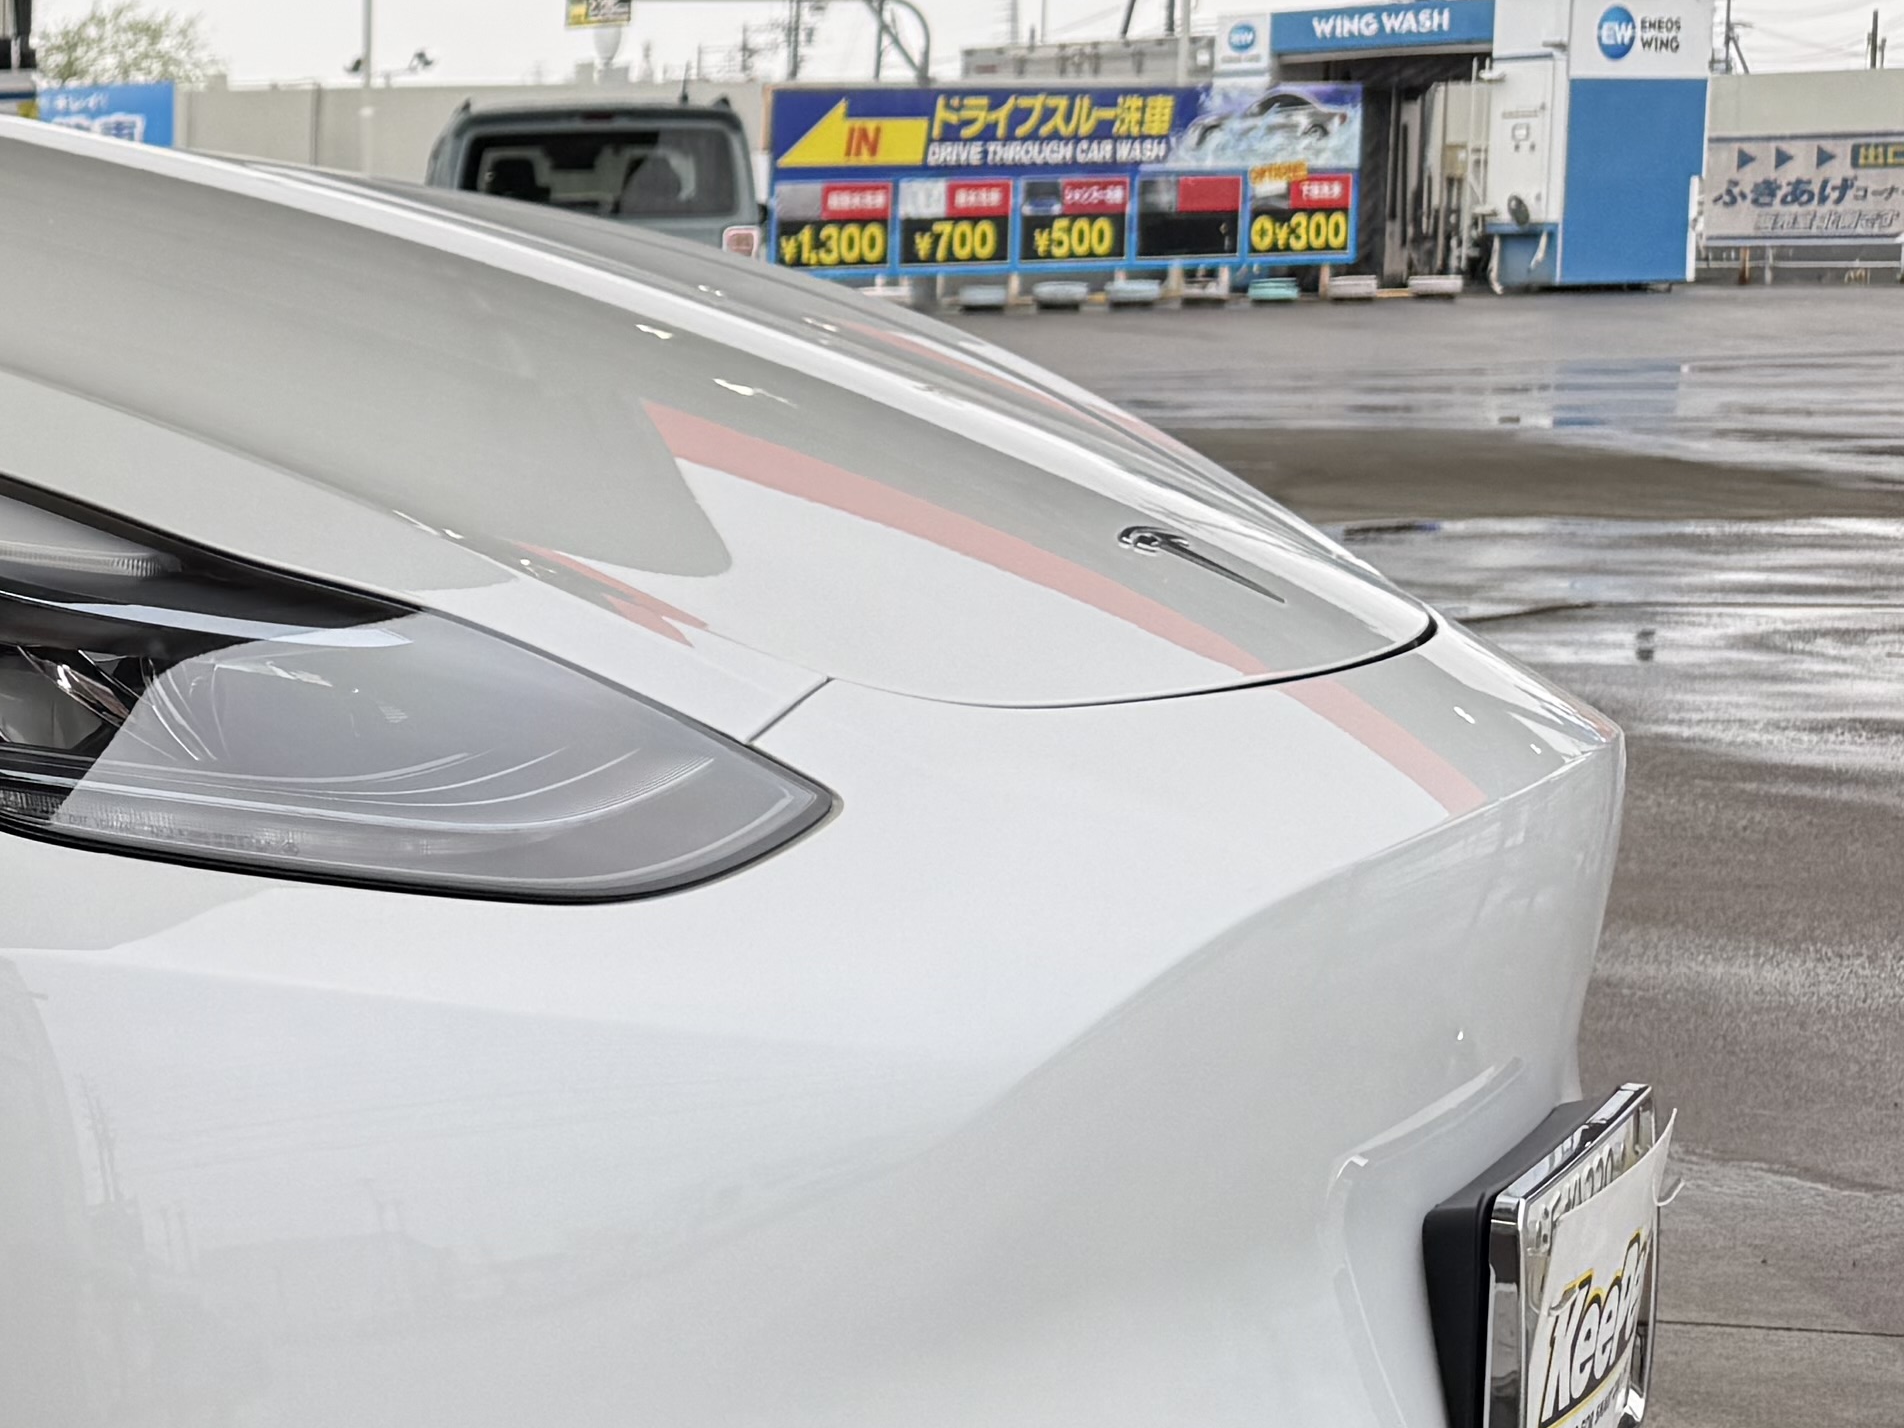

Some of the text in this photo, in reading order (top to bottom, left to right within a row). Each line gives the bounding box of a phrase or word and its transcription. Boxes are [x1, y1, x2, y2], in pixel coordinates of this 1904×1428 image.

[1312, 7, 1450, 40] WING WASH
[1640, 16, 1681, 33] ENEOS
[1640, 35, 1680, 53] WING
[933, 94, 1175, 141] ドライブスルー洗車
[845, 125, 881, 158] IN
[927, 138, 1167, 166] DRIVE THROUGH CAR WASH
[1858, 144, 1904, 166] 出口
[1712, 174, 1904, 208] ふきあげコーナ
[914, 220, 997, 262] ¥700
[1033, 217, 1114, 258] ¥500
[1539, 1234, 1649, 1424] KeePe
